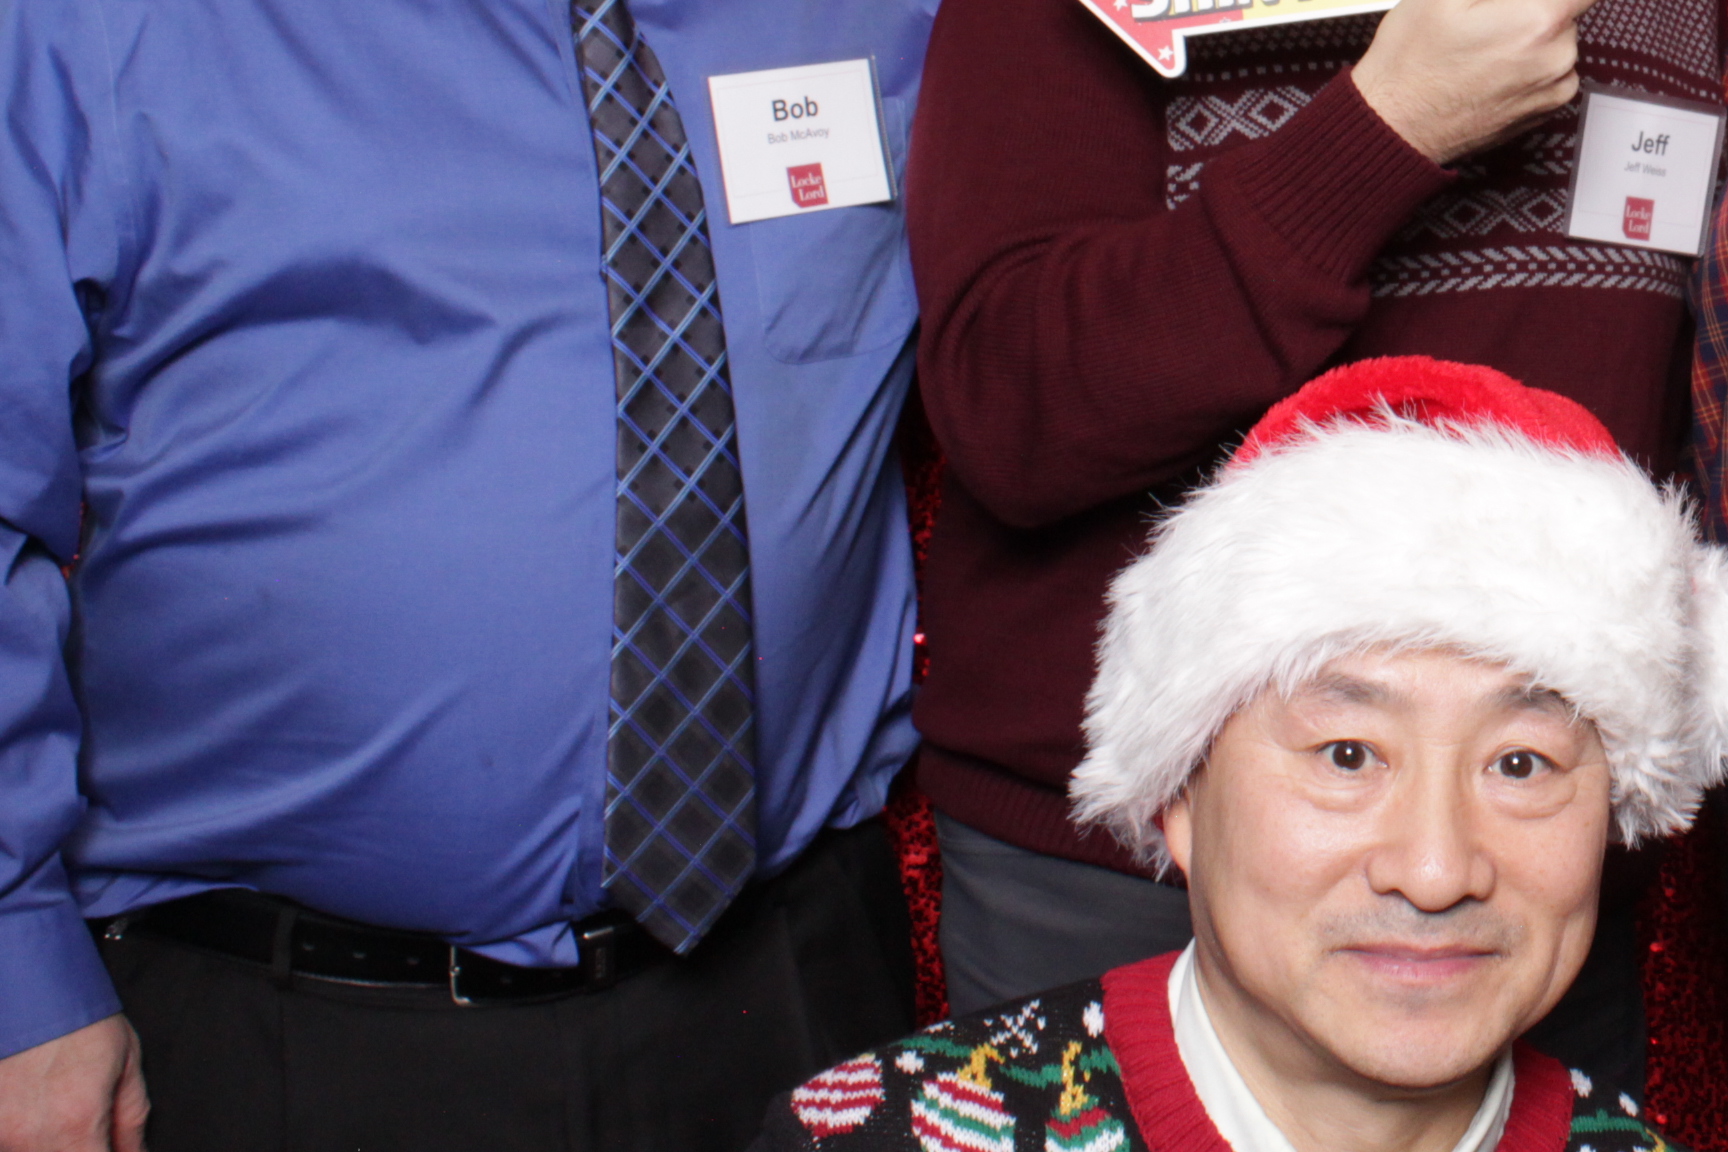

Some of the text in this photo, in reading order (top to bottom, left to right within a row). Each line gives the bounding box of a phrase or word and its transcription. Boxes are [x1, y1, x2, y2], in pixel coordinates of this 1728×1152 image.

[772, 96, 819, 122] Bob
[767, 127, 830, 145] Bob McAvoy
[1631, 131, 1671, 156] Jeff
[1624, 161, 1641, 174] Jeff
[790, 173, 822, 189] Locke
[798, 186, 825, 201] Lord
[1626, 205, 1651, 220] Locke
[1628, 220, 1650, 233] Lord
